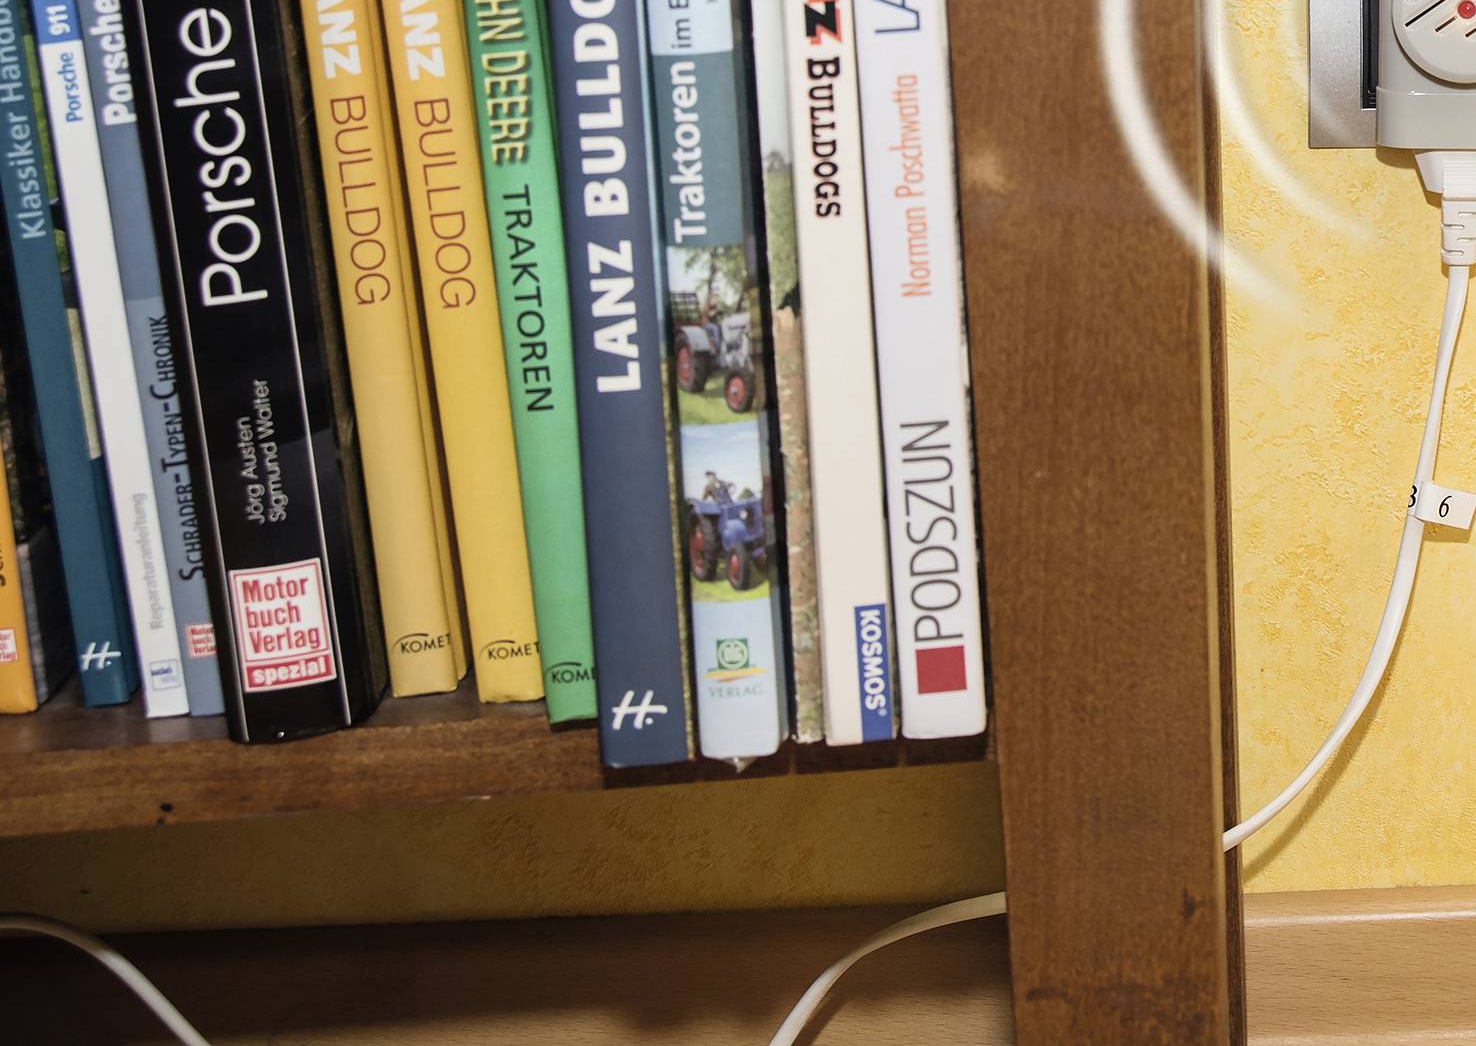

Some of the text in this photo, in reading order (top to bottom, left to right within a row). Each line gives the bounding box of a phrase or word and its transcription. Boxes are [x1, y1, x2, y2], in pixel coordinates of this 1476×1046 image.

[48, 2, 71, 37] 911
[671, 18, 693, 49] im
[63, 51, 82, 123] Porsche
[481, 48, 531, 166] DEERE
[808, 56, 842, 220] BULLDOGS
[7, 111, 47, 241] Klassiker
[173, 7, 269, 307] Porsche
[330, 95, 391, 306] BULLDOG
[413, 98, 477, 310] BULLDOG
[669, 60, 708, 244] Traktoren
[888, 73, 932, 299] Norman Poschwatta
[502, 183, 555, 413] TRAKTOREN
[586, 240, 642, 393] LANZ
[237, 415, 266, 525] Jörg Austen
[252, 378, 289, 523] Sigmund Walter
[1438, 495, 1453, 518] 6
[241, 575, 310, 604] Motor
[899, 419, 965, 644] PODSZUN
[246, 602, 302, 630] buch
[248, 625, 321, 654] Verlag
[252, 655, 326, 685] spezial
[859, 608, 886, 711] KOSMOS
